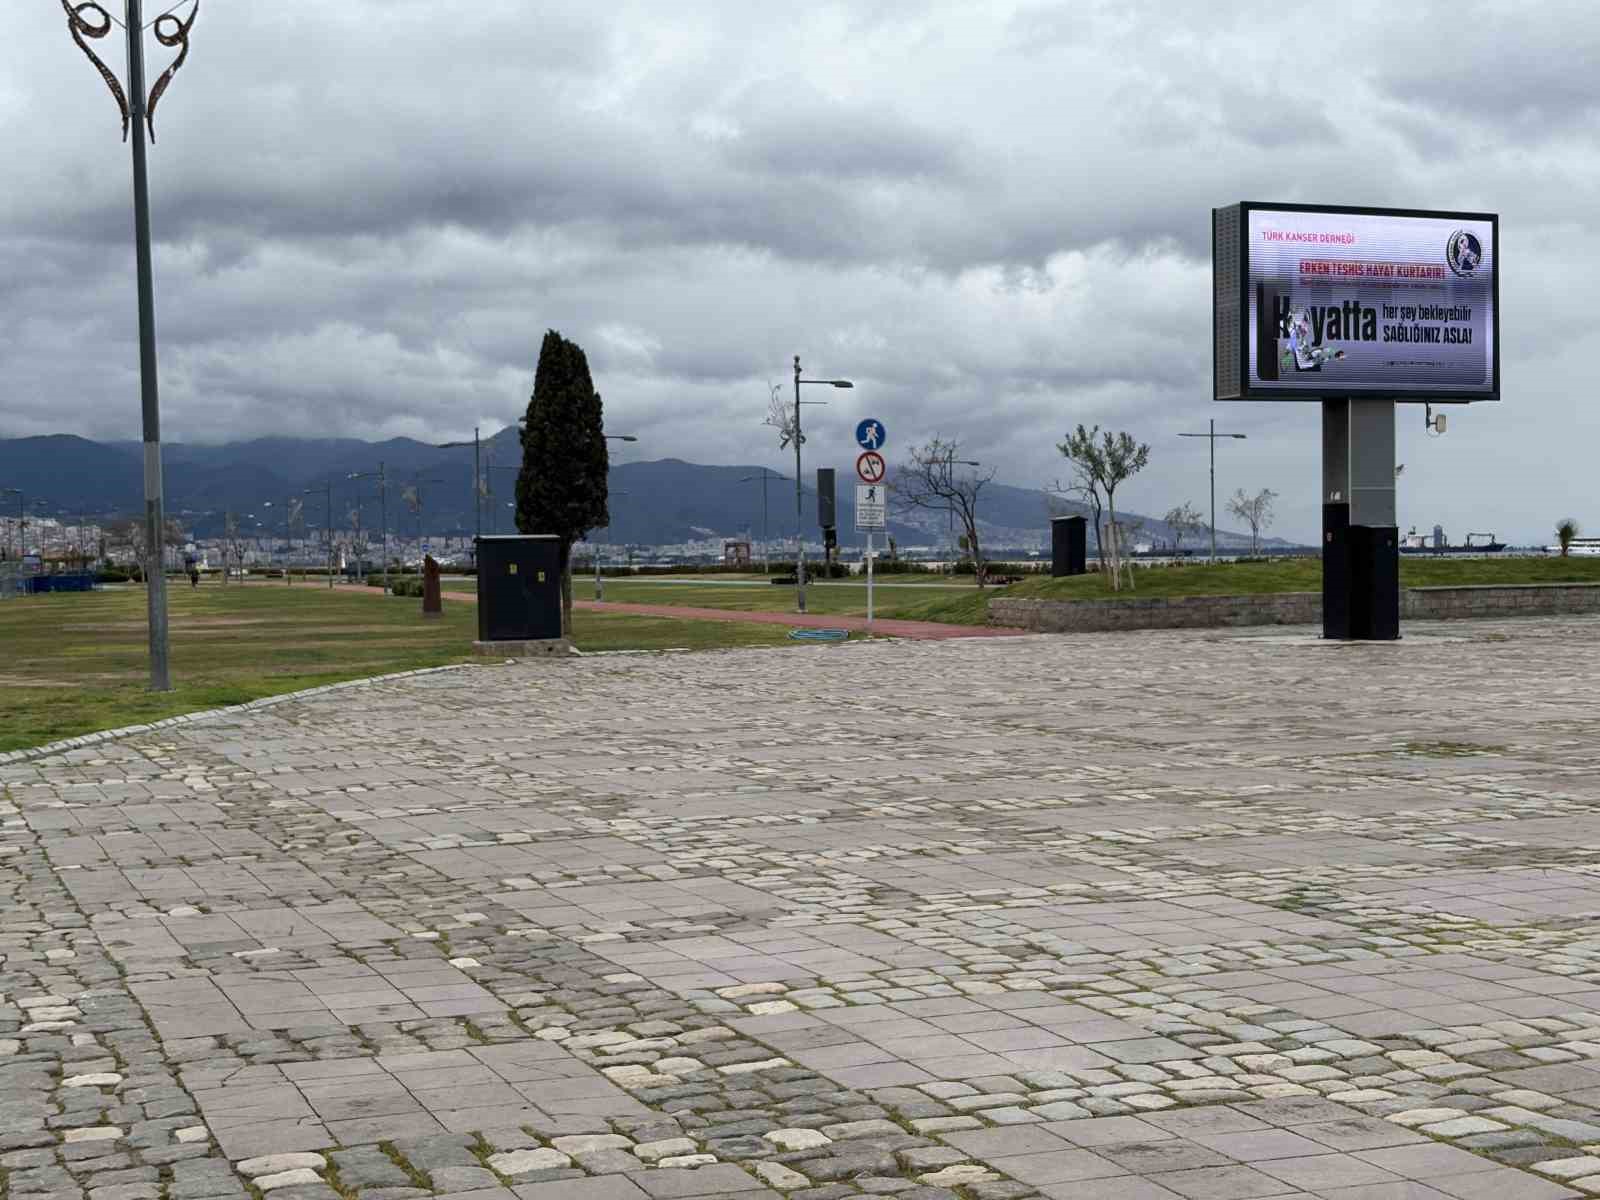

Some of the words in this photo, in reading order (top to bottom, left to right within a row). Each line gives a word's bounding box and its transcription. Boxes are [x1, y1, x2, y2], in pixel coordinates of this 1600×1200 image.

[1285, 231, 1318, 242] KANSER
[1383, 304, 1398, 319] her
[1401, 305, 1417, 321] şey
[1419, 304, 1472, 323] bekleyebilir
